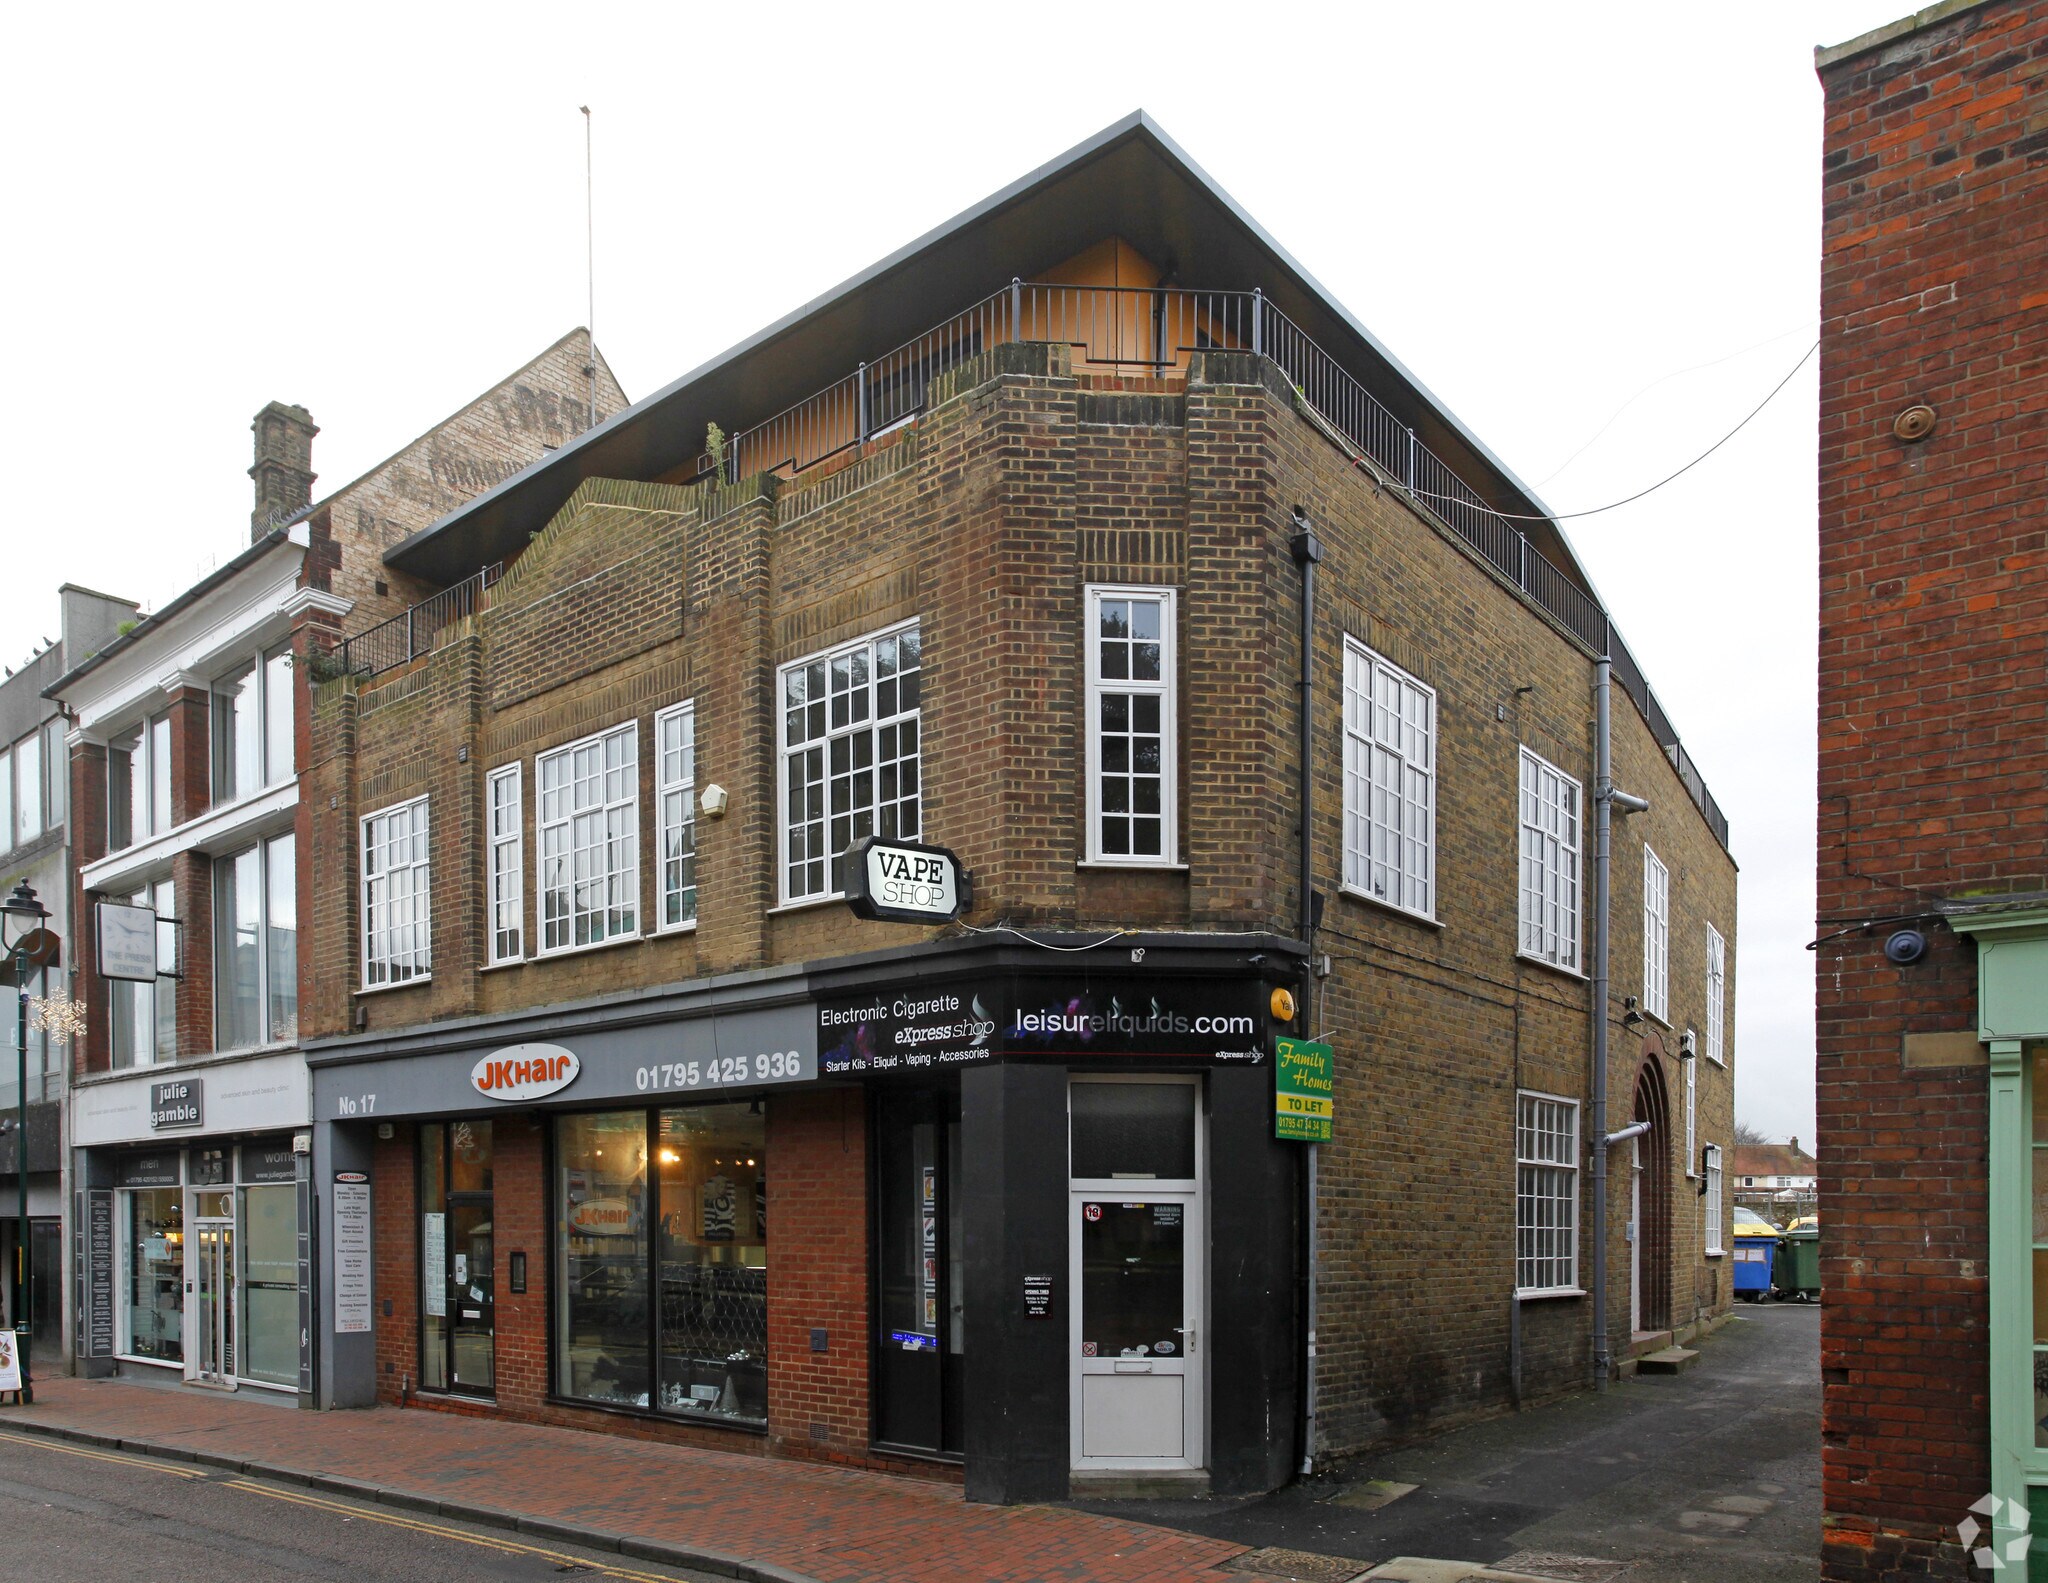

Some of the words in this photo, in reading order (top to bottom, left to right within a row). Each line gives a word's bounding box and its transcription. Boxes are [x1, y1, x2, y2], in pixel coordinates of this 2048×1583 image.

[878, 852, 943, 884] VAPE
[882, 882, 944, 907] SHOP
[106, 950, 122, 960] THE
[124, 952, 152, 963] PRESS
[112, 964, 145, 974] CENTRE
[822, 1005, 888, 1026] Electronic
[894, 995, 959, 1019] Cigarette
[952, 1019, 995, 1038] shop
[826, 1060, 850, 1072] Starter
[852, 1058, 866, 1070] Kits
[874, 1055, 898, 1069] Eliquid
[905, 1052, 931, 1066] Vaping
[939, 1047, 989, 1062] Accessories
[1244, 1051, 1264, 1059] shop
[1278, 1042, 1325, 1074] Family
[636, 1062, 700, 1090] 01795
[707, 1056, 748, 1082] 425
[755, 1050, 800, 1079] 936
[1292, 1068, 1332, 1091] Homes
[159, 1084, 188, 1104] julie
[339, 1096, 356, 1115] No
[360, 1095, 376, 1113] 17
[1288, 1098, 1302, 1110] TO
[1305, 1101, 1323, 1113] LET
[151, 1105, 198, 1126] gamble
[1279, 1117, 1296, 1128] 01795
[1297, 1119, 1303, 1128] 47
[1313, 1120, 1319, 1130] 34
[140, 1159, 159, 1169] men
[264, 1152, 296, 1163] wome
[1087, 1207, 1099, 1217] 18
